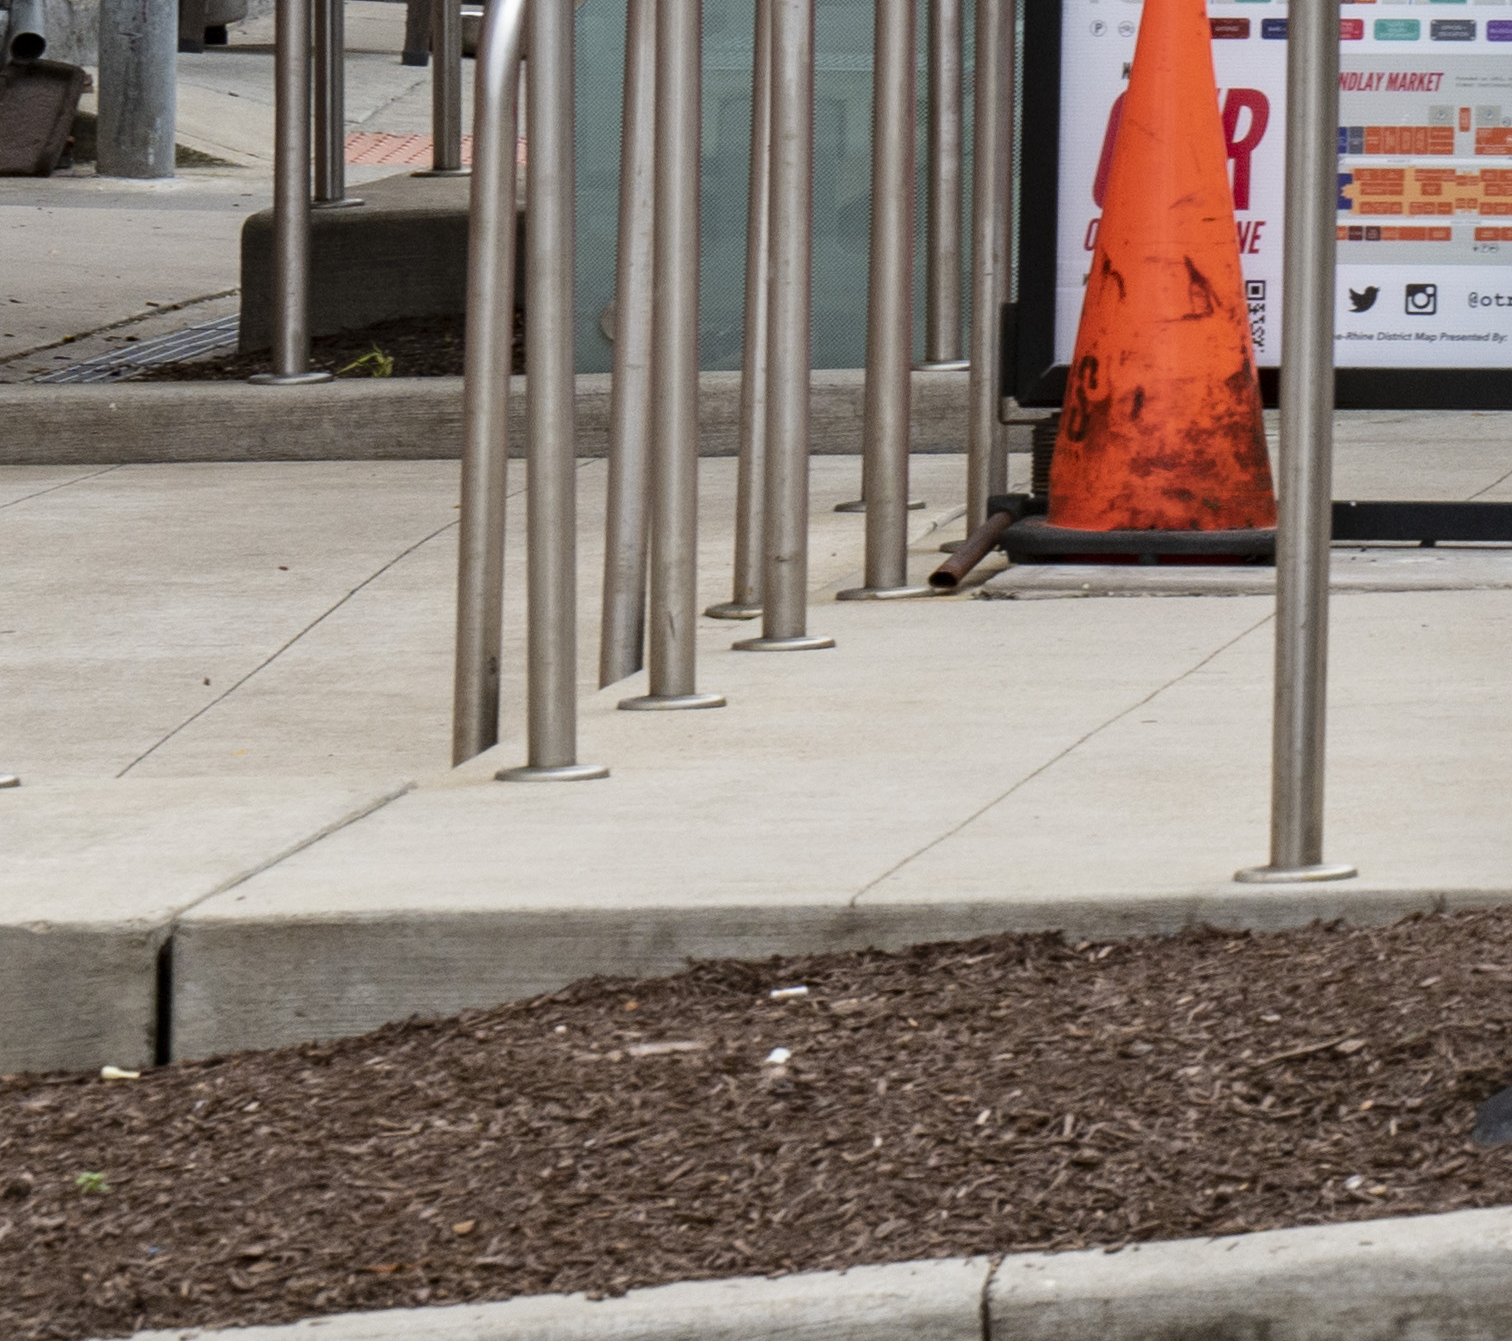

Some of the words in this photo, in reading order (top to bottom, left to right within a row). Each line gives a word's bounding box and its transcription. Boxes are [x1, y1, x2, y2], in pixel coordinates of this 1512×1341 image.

[1386, 72, 1445, 92] MARKET
[1377, 332, 1412, 341] District
[1415, 332, 1437, 343] Map
[1440, 332, 1490, 341] Presented
